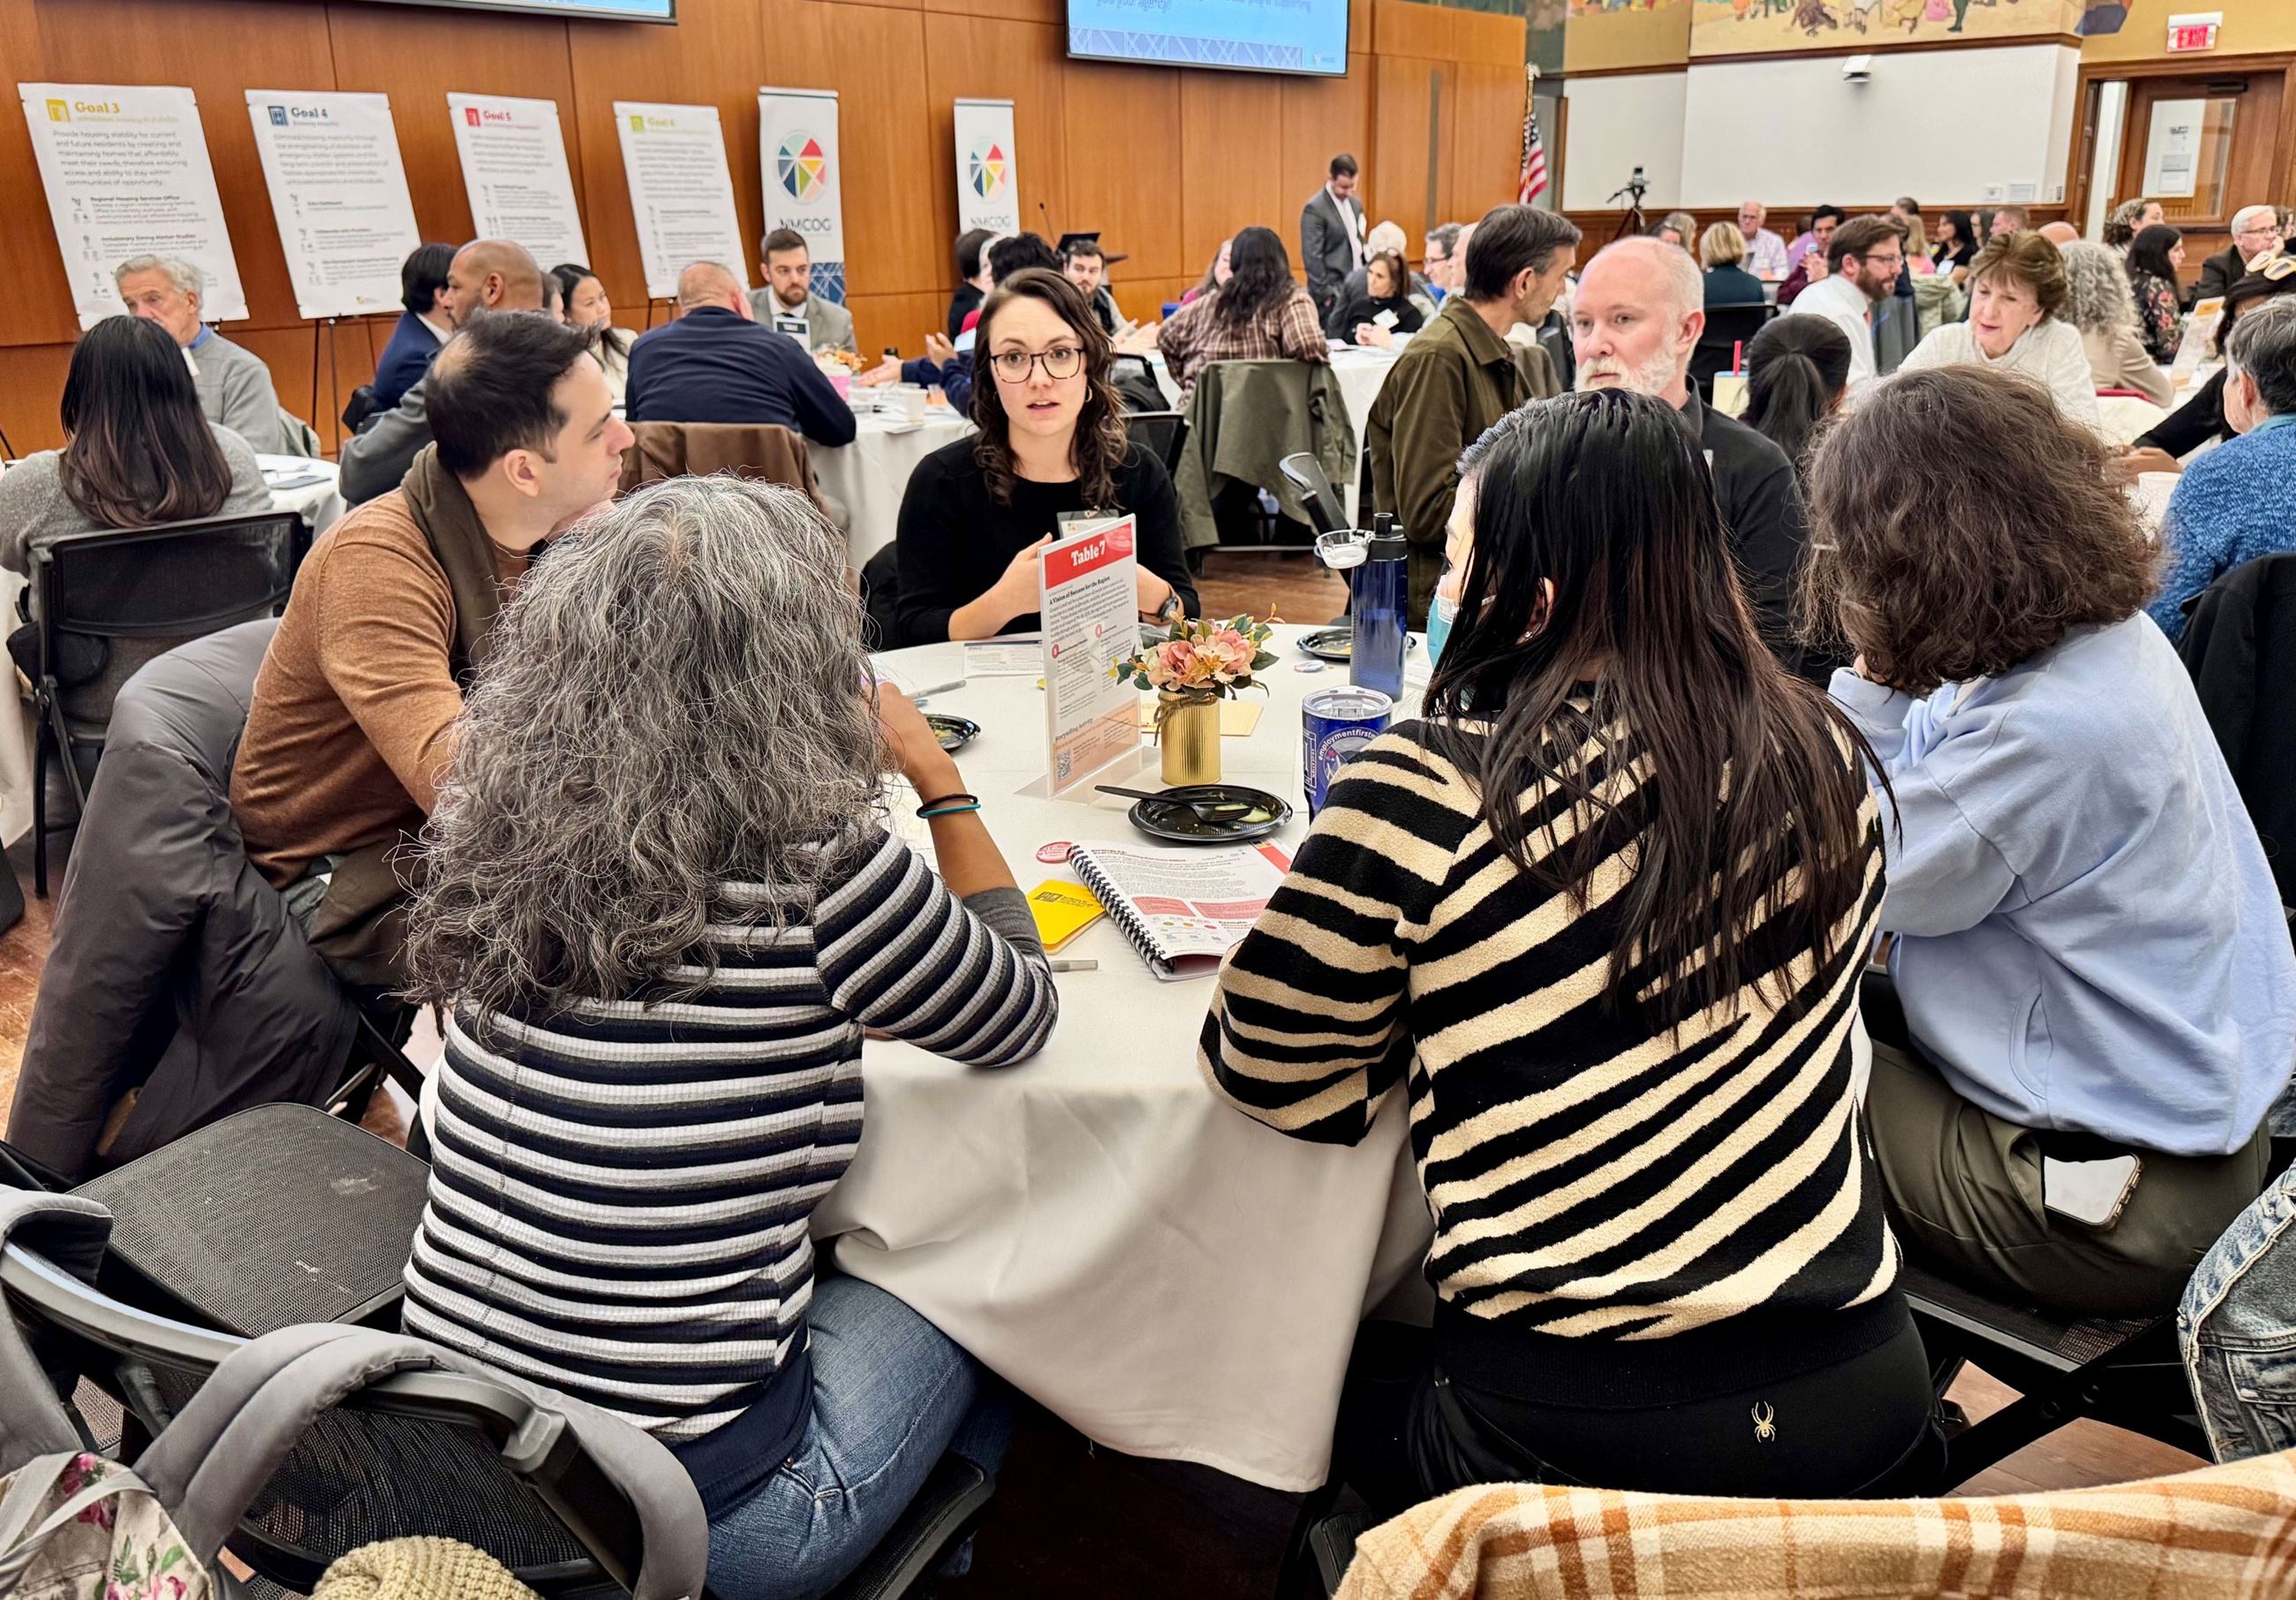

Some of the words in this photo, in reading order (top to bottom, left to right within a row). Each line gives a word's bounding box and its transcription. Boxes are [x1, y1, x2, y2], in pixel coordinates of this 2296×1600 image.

[2177, 26, 2208, 48] EXIT
[75, 102, 109, 113] Goal
[112, 102, 120, 113] 3
[291, 107, 319, 117] Goal
[321, 109, 329, 117] 4
[483, 110, 504, 120] Goal
[1070, 543, 1099, 567] Table
[1099, 540, 1106, 555] 7
